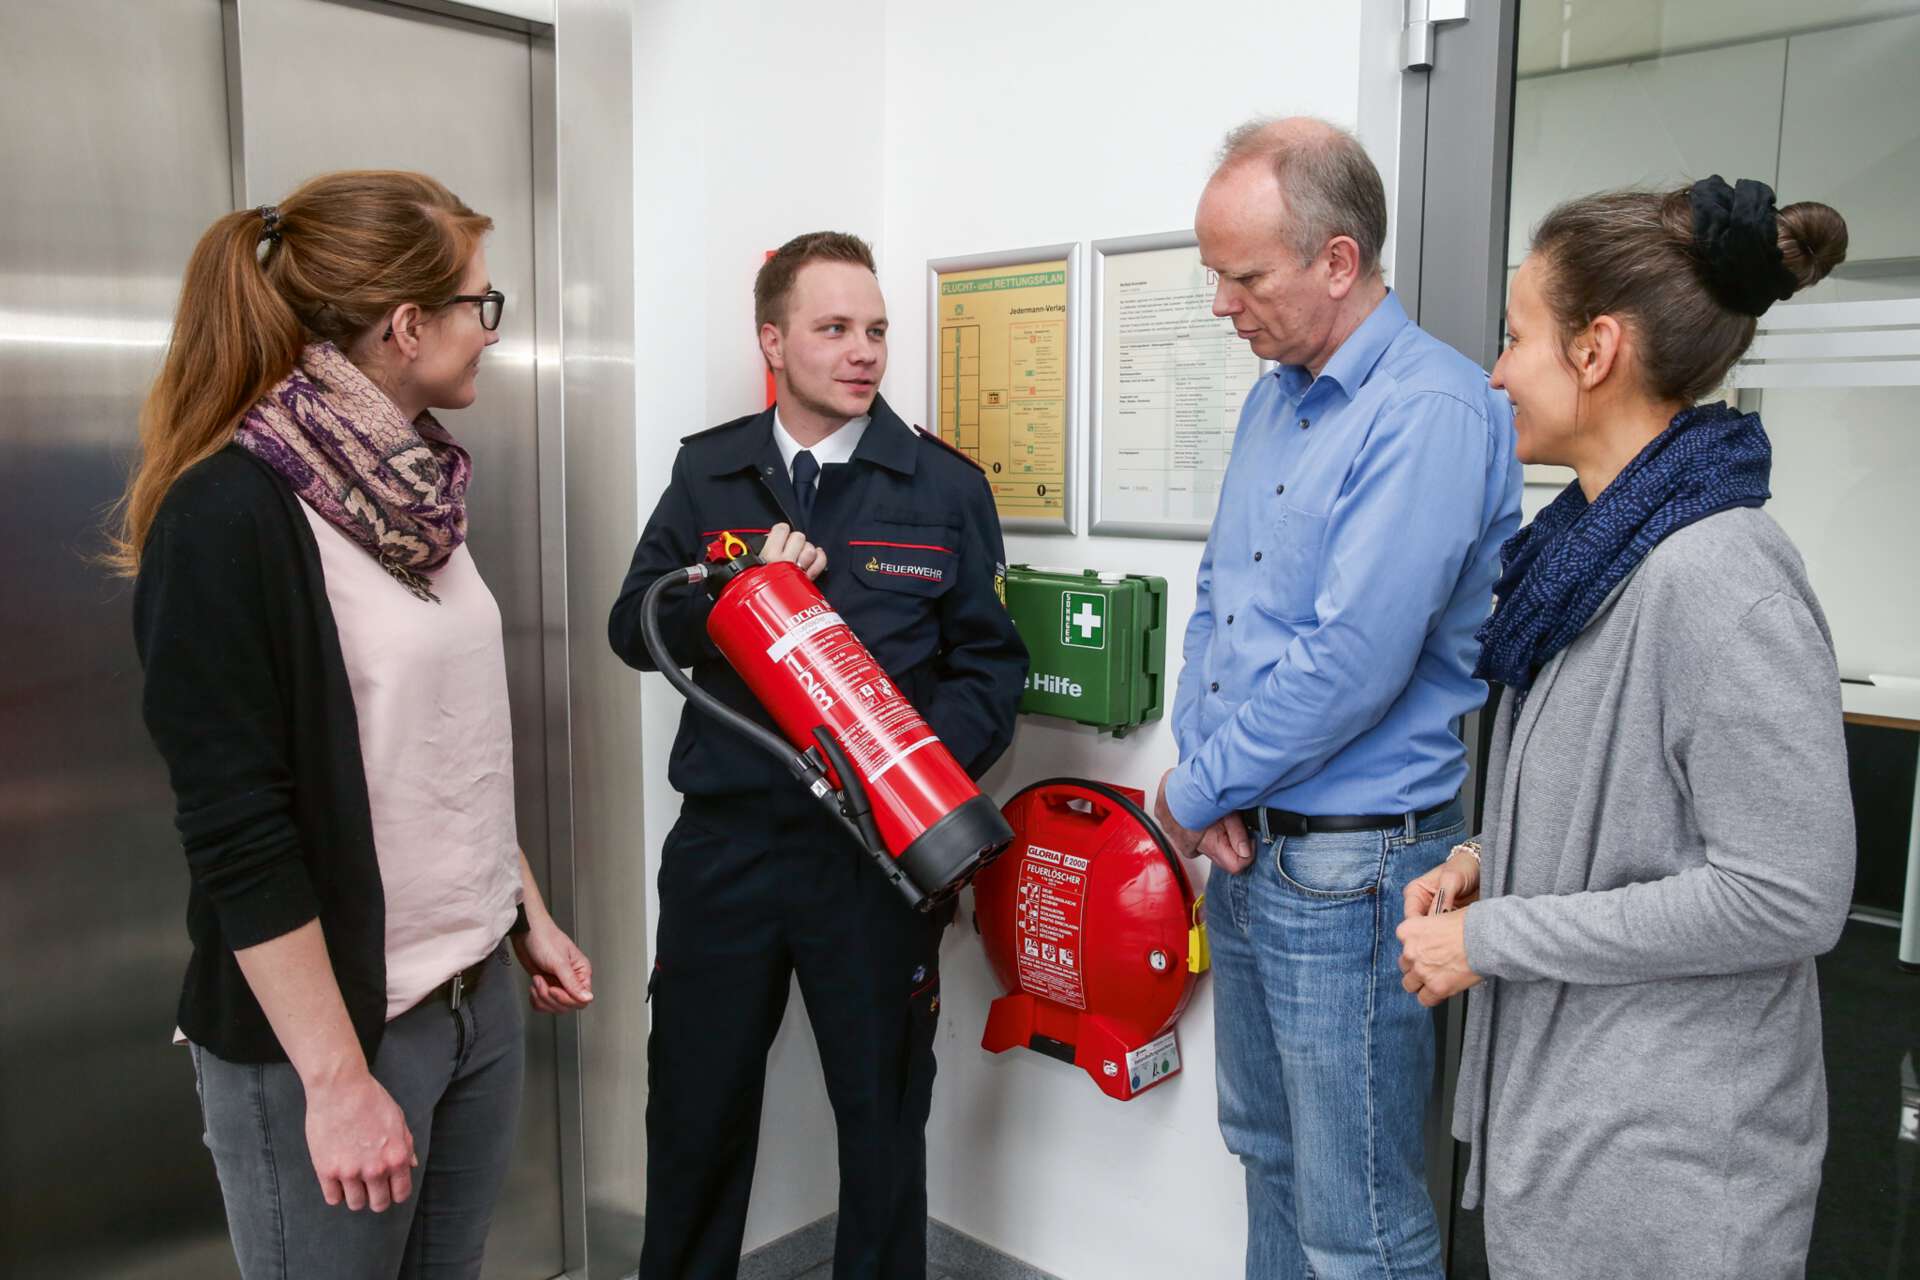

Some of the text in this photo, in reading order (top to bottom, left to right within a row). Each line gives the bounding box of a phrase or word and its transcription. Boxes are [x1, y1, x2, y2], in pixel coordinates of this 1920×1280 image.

[994, 274, 1064, 289] RETTUNGSPLAN
[1009, 304, 1066, 316] Jedermann-Verlag
[880, 562, 943, 580] FEUERWEHR
[785, 654, 804, 674] 1
[799, 671, 821, 694] 2
[1033, 672, 1082, 698] Hilfe
[812, 687, 834, 712] 3
[1028, 847, 1060, 862] GLORIA
[1027, 863, 1081, 886] FEUERLÖSCHER
